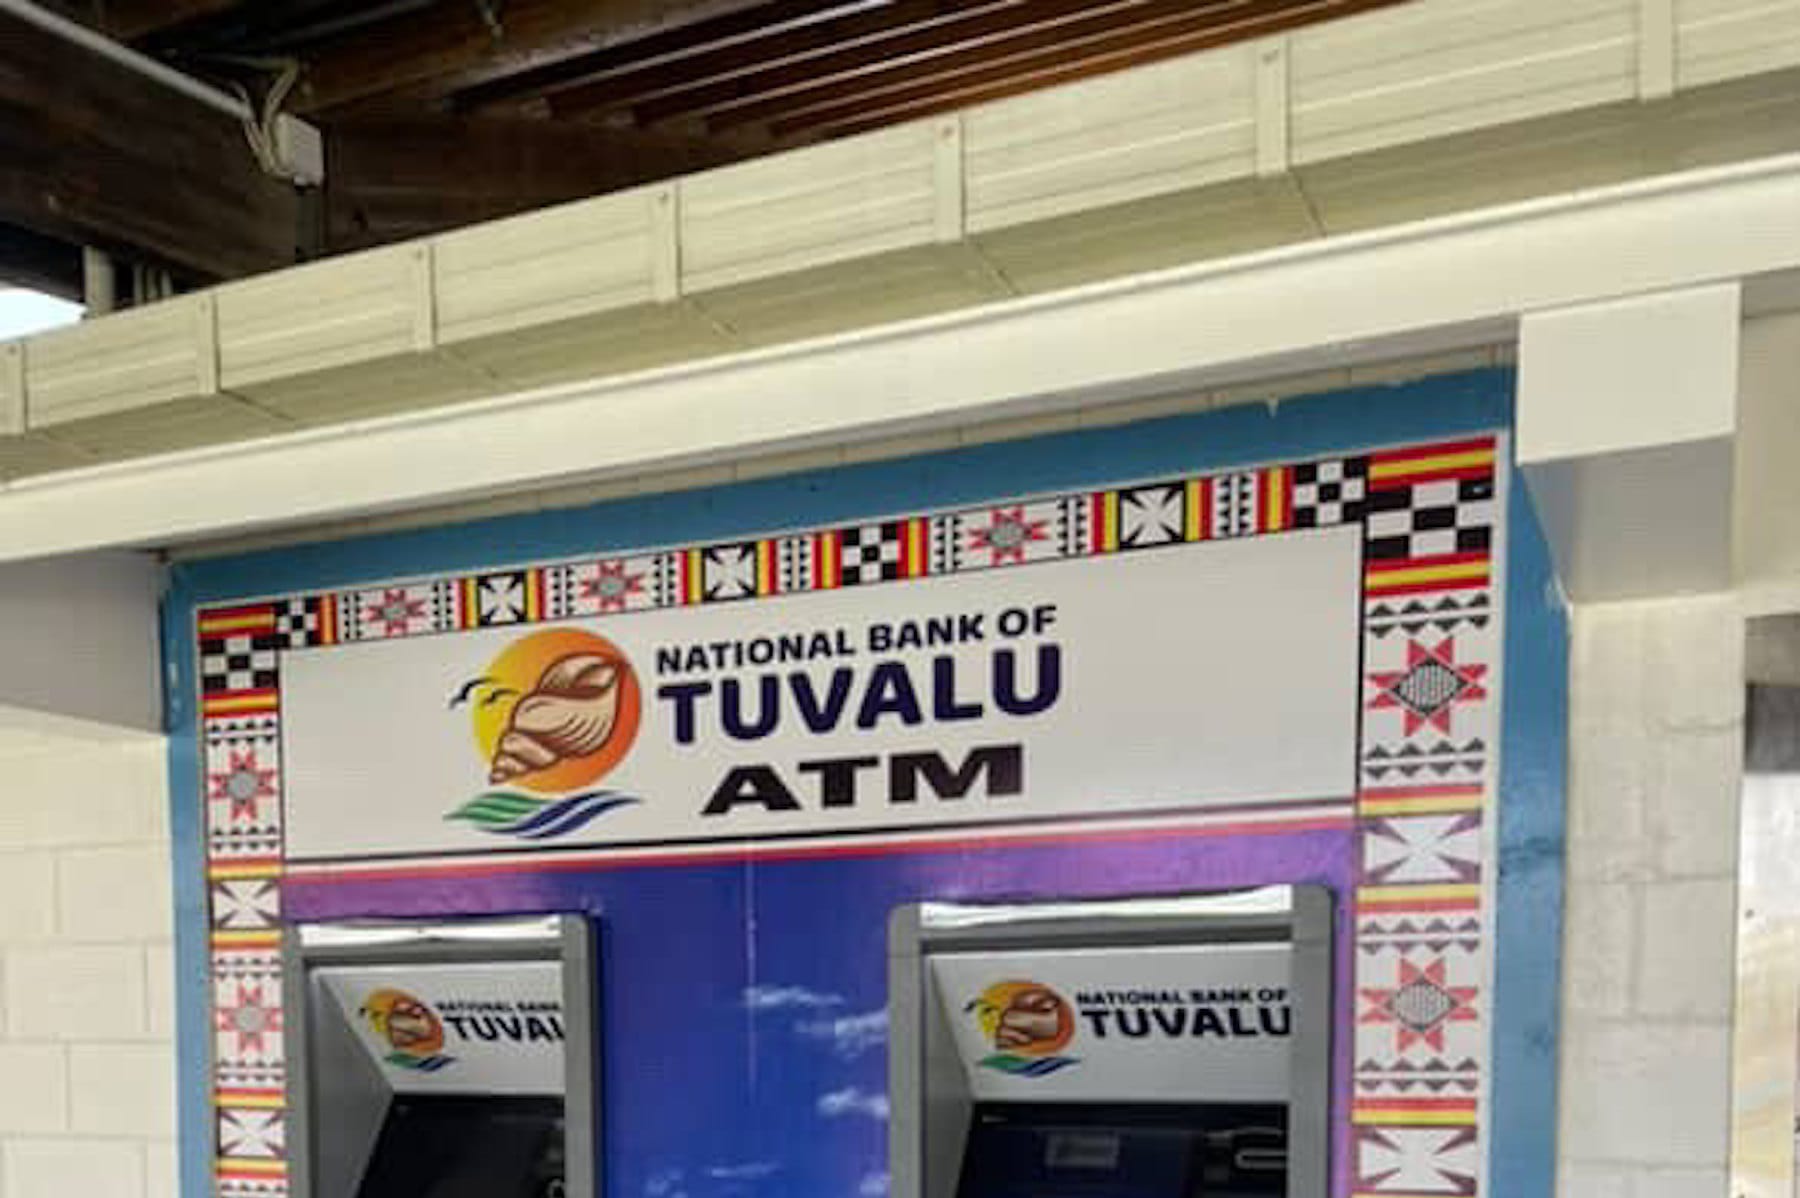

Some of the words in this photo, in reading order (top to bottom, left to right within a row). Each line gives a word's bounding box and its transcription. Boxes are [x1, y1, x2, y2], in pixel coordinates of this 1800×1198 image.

[656, 630, 856, 675] NATIONAL
[868, 613, 985, 653] BANK
[997, 604, 1058, 637] OF
[656, 643, 1062, 744] TUVALU
[700, 743, 1024, 817] ATM
[1076, 989, 1184, 1005] NATIONAL
[1190, 988, 1254, 1003] BANK
[1258, 987, 1288, 1002] OF
[1081, 1005, 1292, 1039] TUVALU
